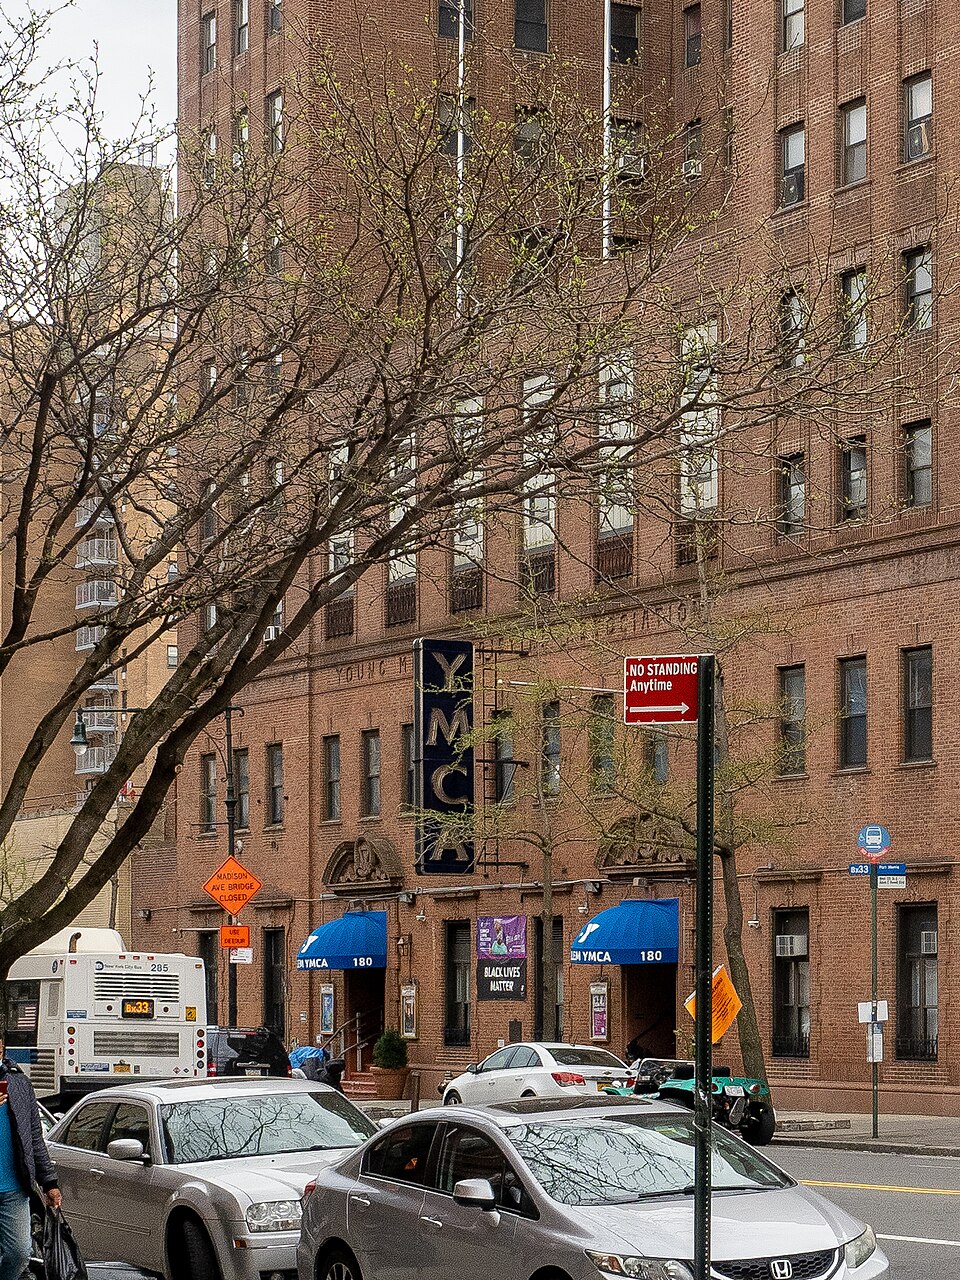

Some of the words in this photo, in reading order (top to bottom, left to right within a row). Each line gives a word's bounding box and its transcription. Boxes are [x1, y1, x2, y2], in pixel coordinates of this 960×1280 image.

[630, 664, 644, 676] NO
[647, 662, 698, 676] STANDING
[630, 678, 673, 694] Anytime
[426, 651, 471, 862] YMCA
[850, 865, 869, 874] Bx33
[228, 883, 255, 891] BRIDGE
[582, 951, 612, 962] YMCA
[641, 950, 662, 961] 180
[150, 963, 169, 972] 285
[305, 958, 329, 968] YMCA
[352, 957, 373, 967] 180
[484, 967, 503, 978] BLACK
[503, 966, 520, 978] LIVES
[490, 980, 514, 992] MATTER
[126, 1001, 149, 1013] Bx33
